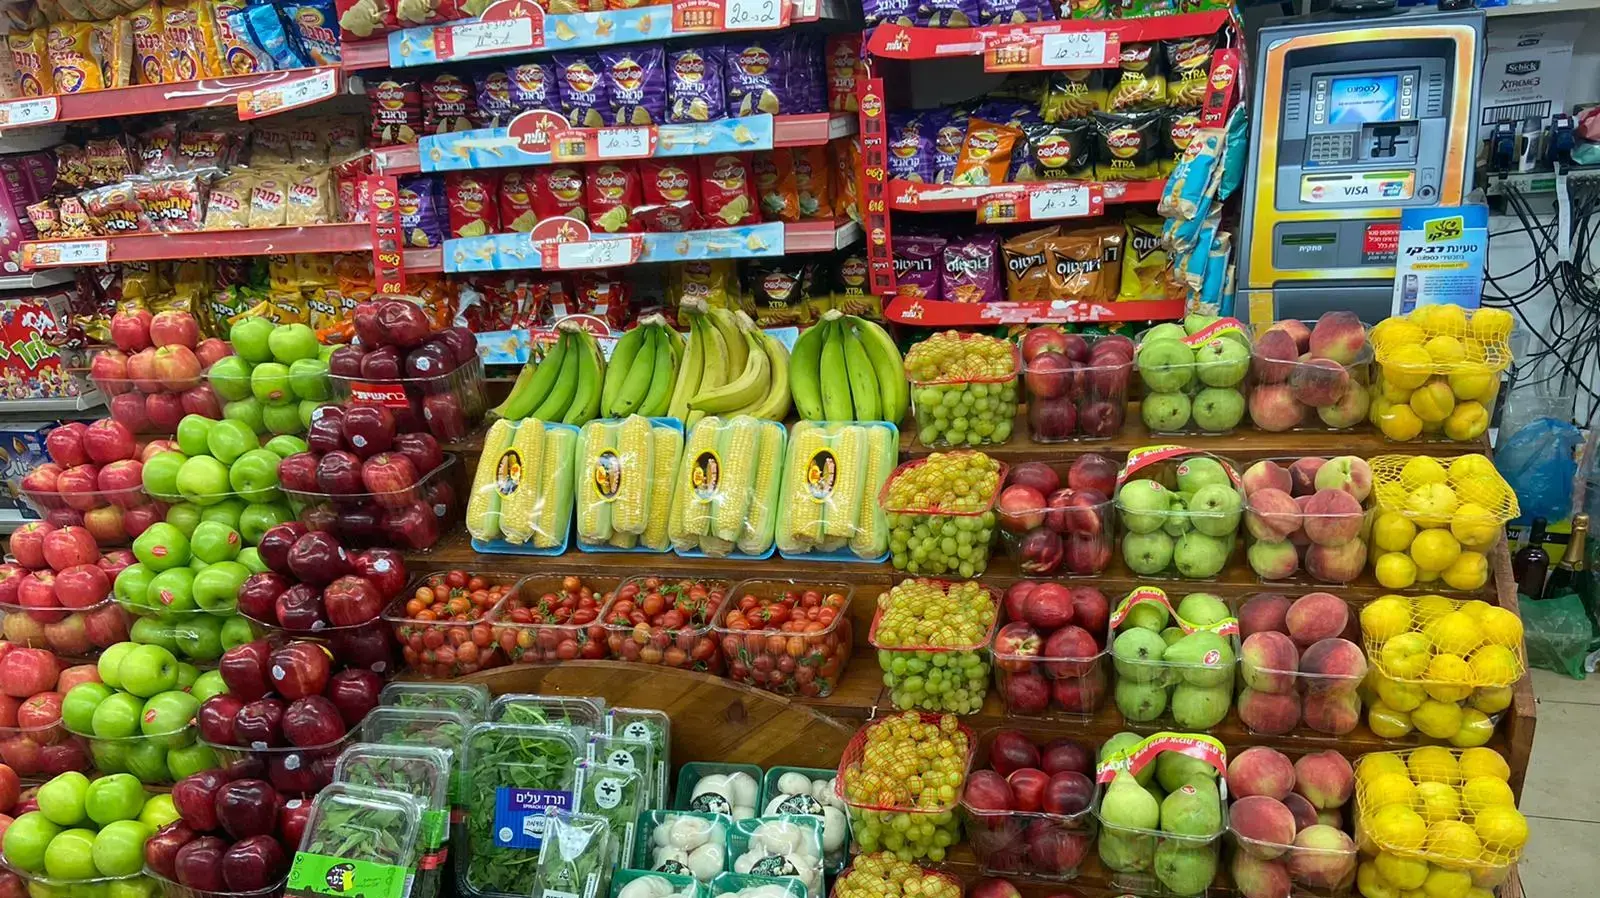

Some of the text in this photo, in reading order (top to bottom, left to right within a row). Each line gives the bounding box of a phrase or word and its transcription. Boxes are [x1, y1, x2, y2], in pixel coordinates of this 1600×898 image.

[731, 3, 749, 24] 20
[761, 1, 775, 22] 2
[1508, 62, 1537, 73] Schick
[1121, 72, 1145, 82] XTRA
[1181, 68, 1206, 82] XTRA
[321, 81, 329, 90] 3
[378, 109, 408, 121] קראנצ'
[631, 136, 641, 147] 3
[1037, 143, 1070, 157] תפוצ'יפס
[1111, 159, 1135, 168] XTRA
[1043, 170, 1068, 178] XTRA
[252, 188, 281, 204] במבה
[1344, 187, 1369, 196] VISA
[1069, 195, 1077, 206] 3
[1299, 245, 1322, 253] פתקית
[1406, 246, 1444, 256] רב-קו
[1447, 245, 1478, 254] טעינת
[946, 256, 992, 273] דוריטוס
[1009, 253, 1045, 270] וריטוס
[845, 287, 864, 296] XTRA
[768, 300, 788, 309] XTRA
[516, 791, 566, 805] תרד עלים
